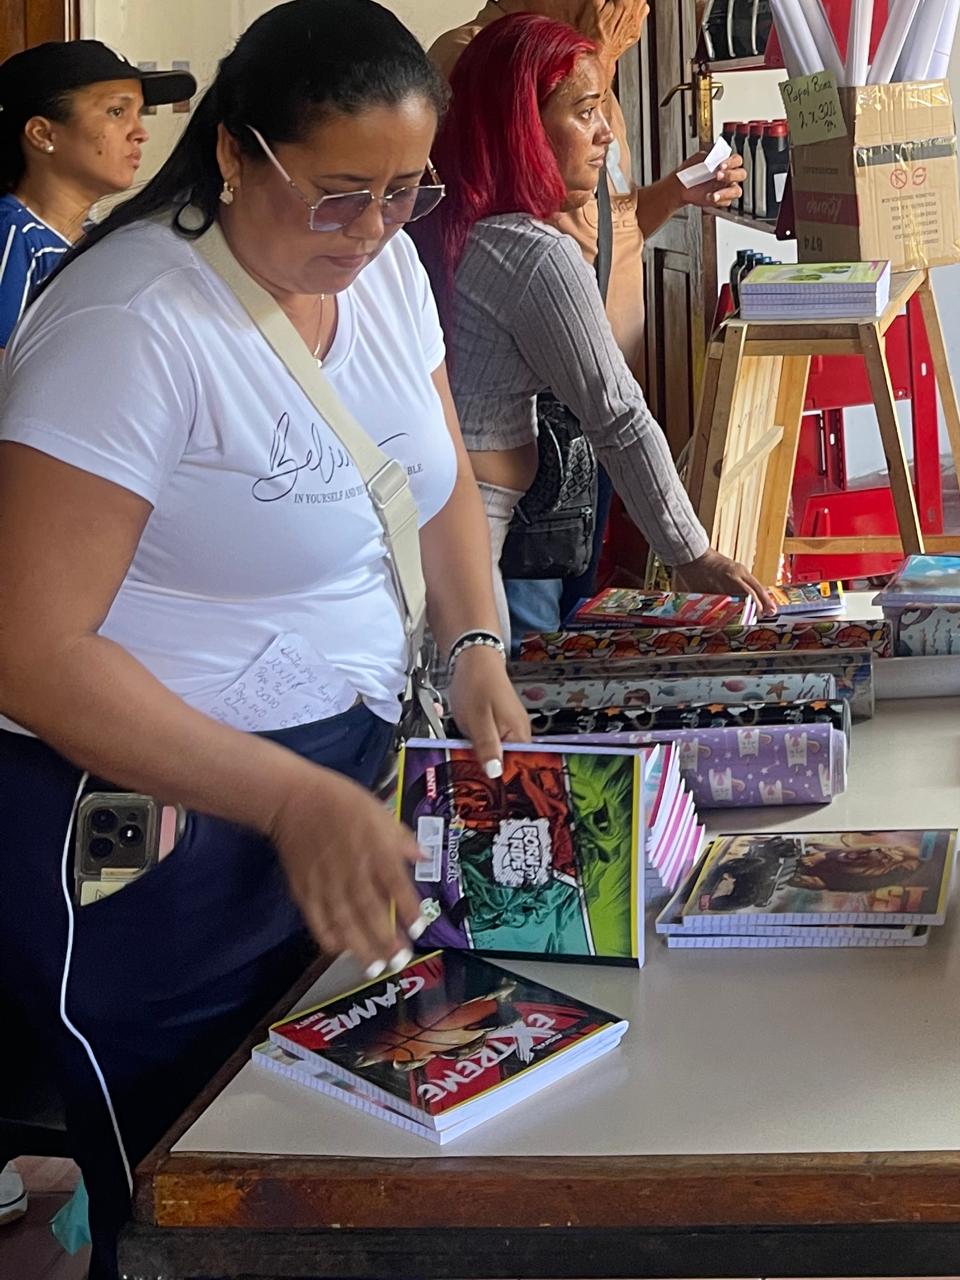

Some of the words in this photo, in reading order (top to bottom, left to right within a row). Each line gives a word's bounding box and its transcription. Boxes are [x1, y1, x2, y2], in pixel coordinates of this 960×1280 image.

[294, 493, 304, 505] IN
[305, 489, 343, 505] YOURSELF
[426, 767, 437, 799] FANTY
[509, 838, 525, 870] RIDE
[523, 826, 541, 867] BORN
[312, 976, 425, 1041] GAME
[417, 1013, 556, 1103] EXTREME
